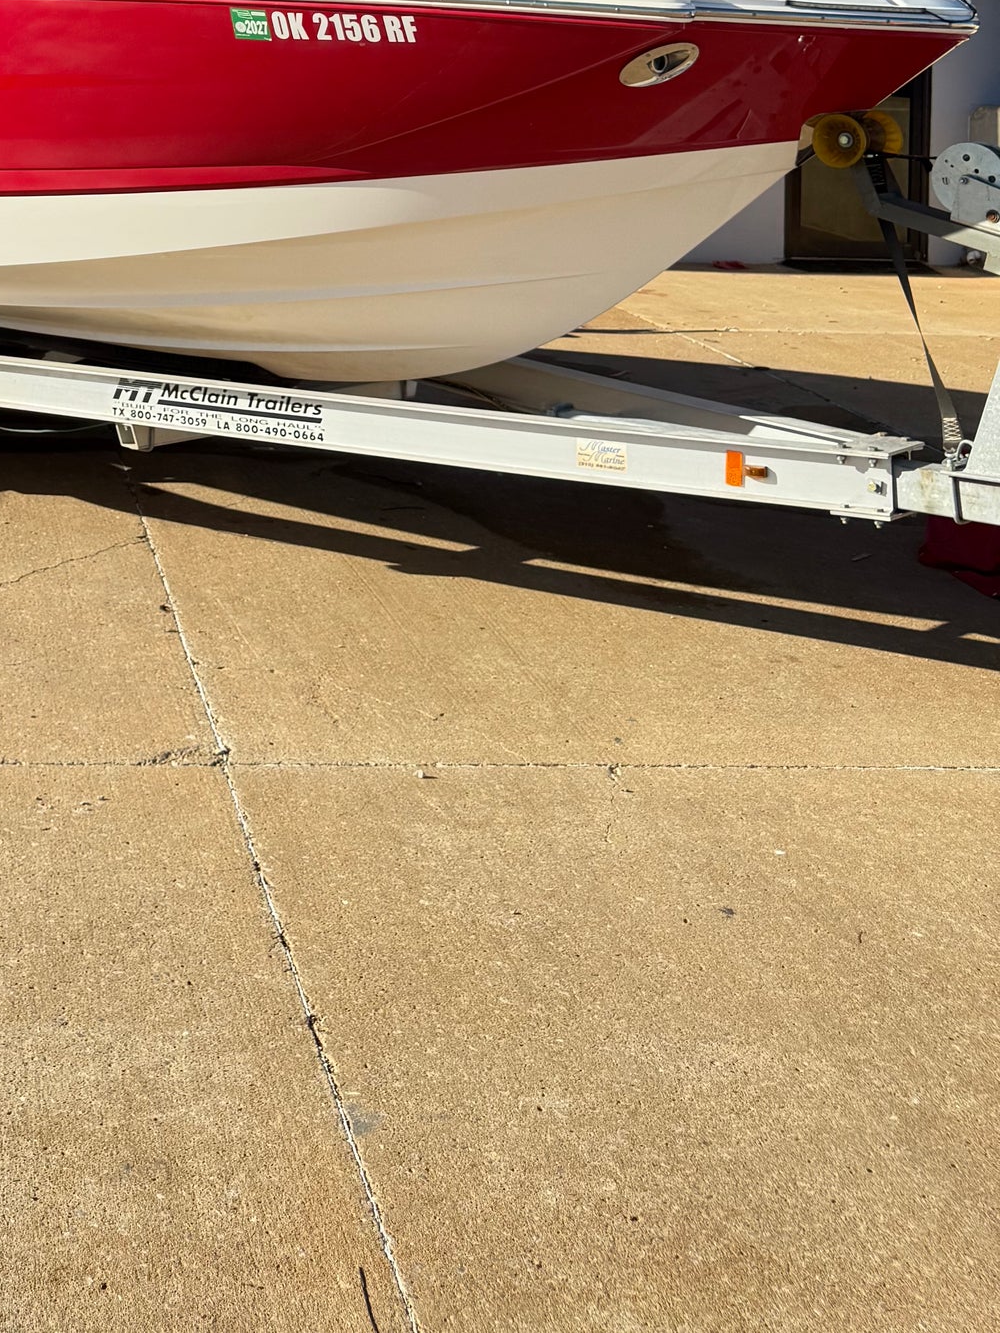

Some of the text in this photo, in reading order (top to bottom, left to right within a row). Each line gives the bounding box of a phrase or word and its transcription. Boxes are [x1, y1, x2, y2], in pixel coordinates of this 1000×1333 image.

[244, 19, 268, 36] 2027
[271, 10, 417, 43] OK 2156 RF
[161, 382, 239, 406] McClain
[247, 392, 323, 416] Trailers
[112, 407, 325, 441] TX 800-747-3059 LA 800-490-0664
